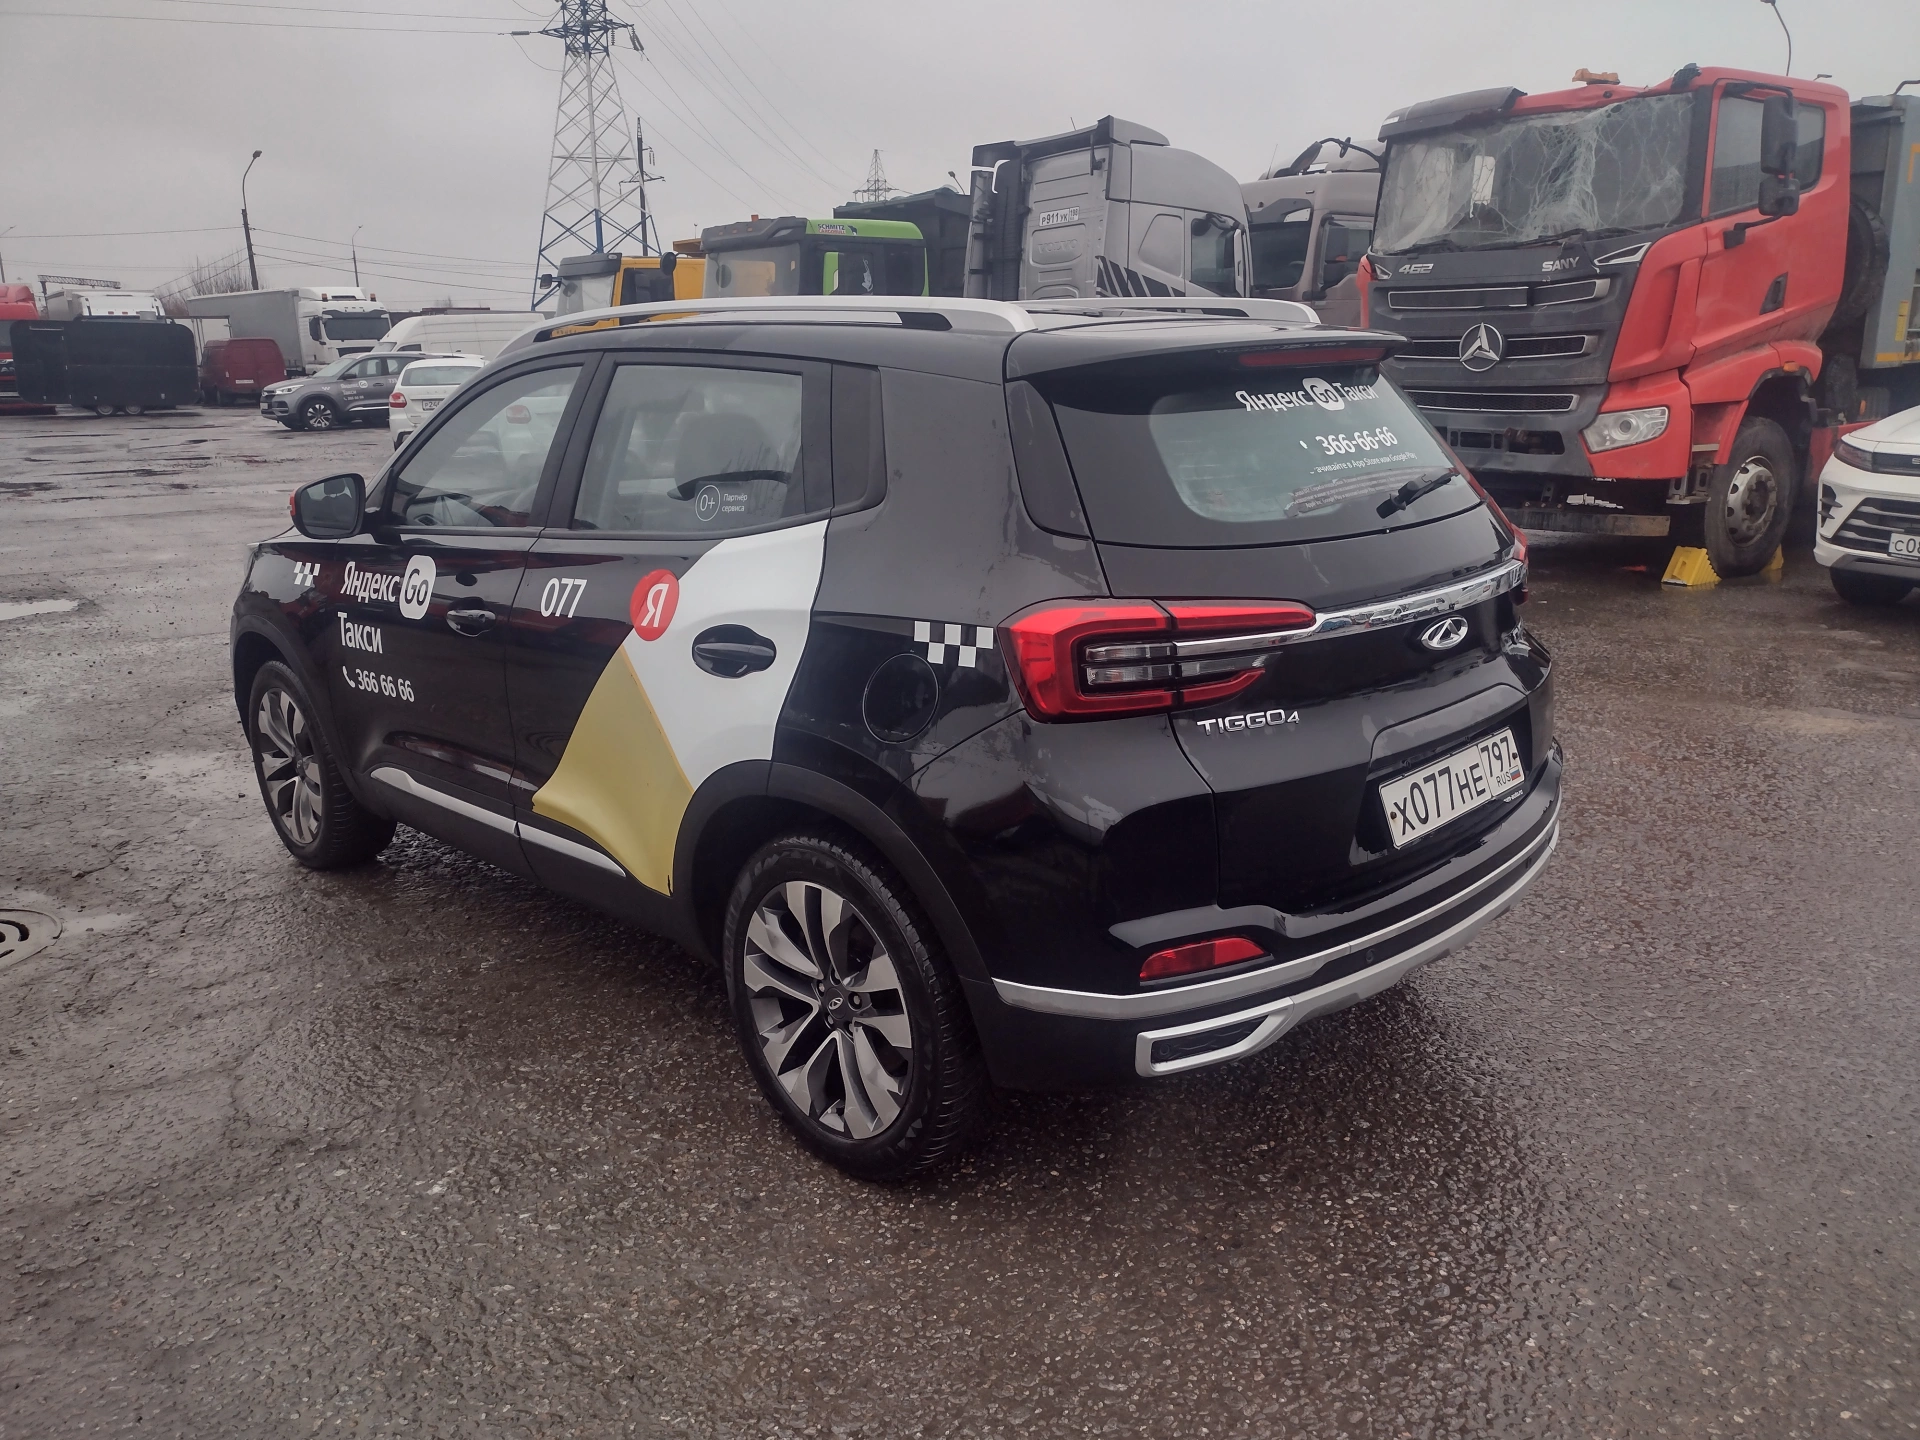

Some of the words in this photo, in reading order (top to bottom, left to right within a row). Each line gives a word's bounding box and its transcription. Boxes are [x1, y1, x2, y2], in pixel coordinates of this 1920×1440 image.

[817, 223, 846, 231] SCHMITZ
[1398, 263, 1434, 275] 462
[1541, 256, 1580, 272] SANY
[1235, 390, 1314, 412] Яндекс
[1309, 384, 1340, 403] Go
[1332, 382, 1379, 401] Такси
[1315, 426, 1398, 456] 366-66-66
[1352, 459, 1366, 469] App
[1364, 457, 1380, 466] Store
[1389, 452, 1407, 462] Google
[700, 494, 716, 511] 0+
[723, 493, 748, 502] Партнёр
[721, 505, 745, 513] сервиса
[339, 561, 400, 604] Яндекс
[404, 568, 430, 606] Go
[540, 577, 588, 619] 077
[640, 583, 669, 628] Я
[337, 612, 383, 654] Такси
[355, 668, 379, 694] 366
[380, 673, 397, 698] 66
[397, 678, 415, 703] 66
[1495, 771, 1512, 787] RUS
